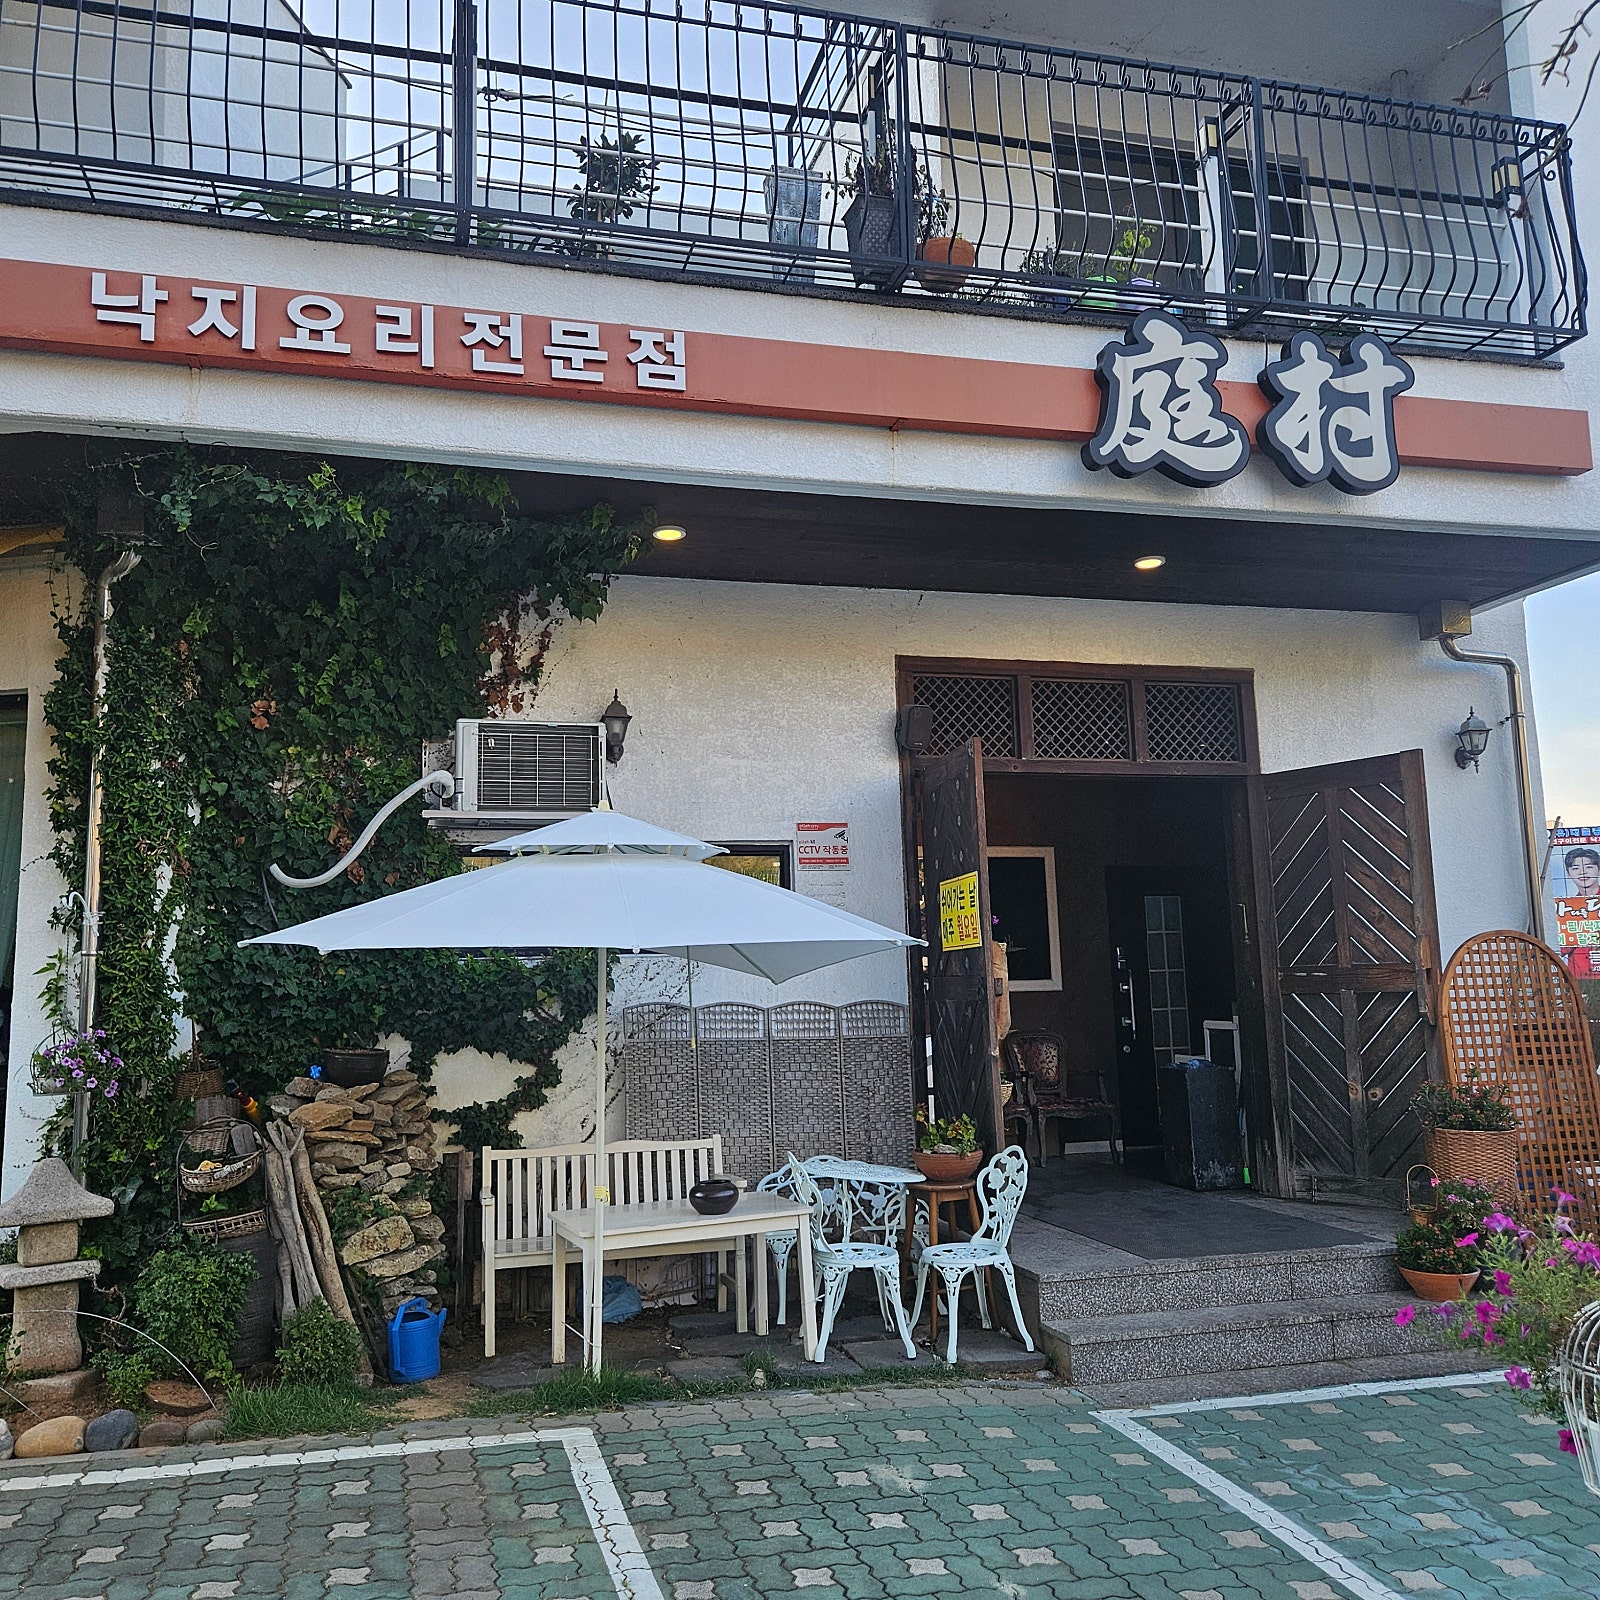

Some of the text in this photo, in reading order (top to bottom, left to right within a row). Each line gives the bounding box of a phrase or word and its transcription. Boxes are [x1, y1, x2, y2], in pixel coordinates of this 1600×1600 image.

[91, 272, 687, 392] 낙지요리전문점
[1096, 315, 1409, 485] 庭村
[799, 845, 848, 855] CCTV 작동중
[942, 881, 976, 914] 쉬어가는 날
[943, 912, 978, 943] 매주 월요일
